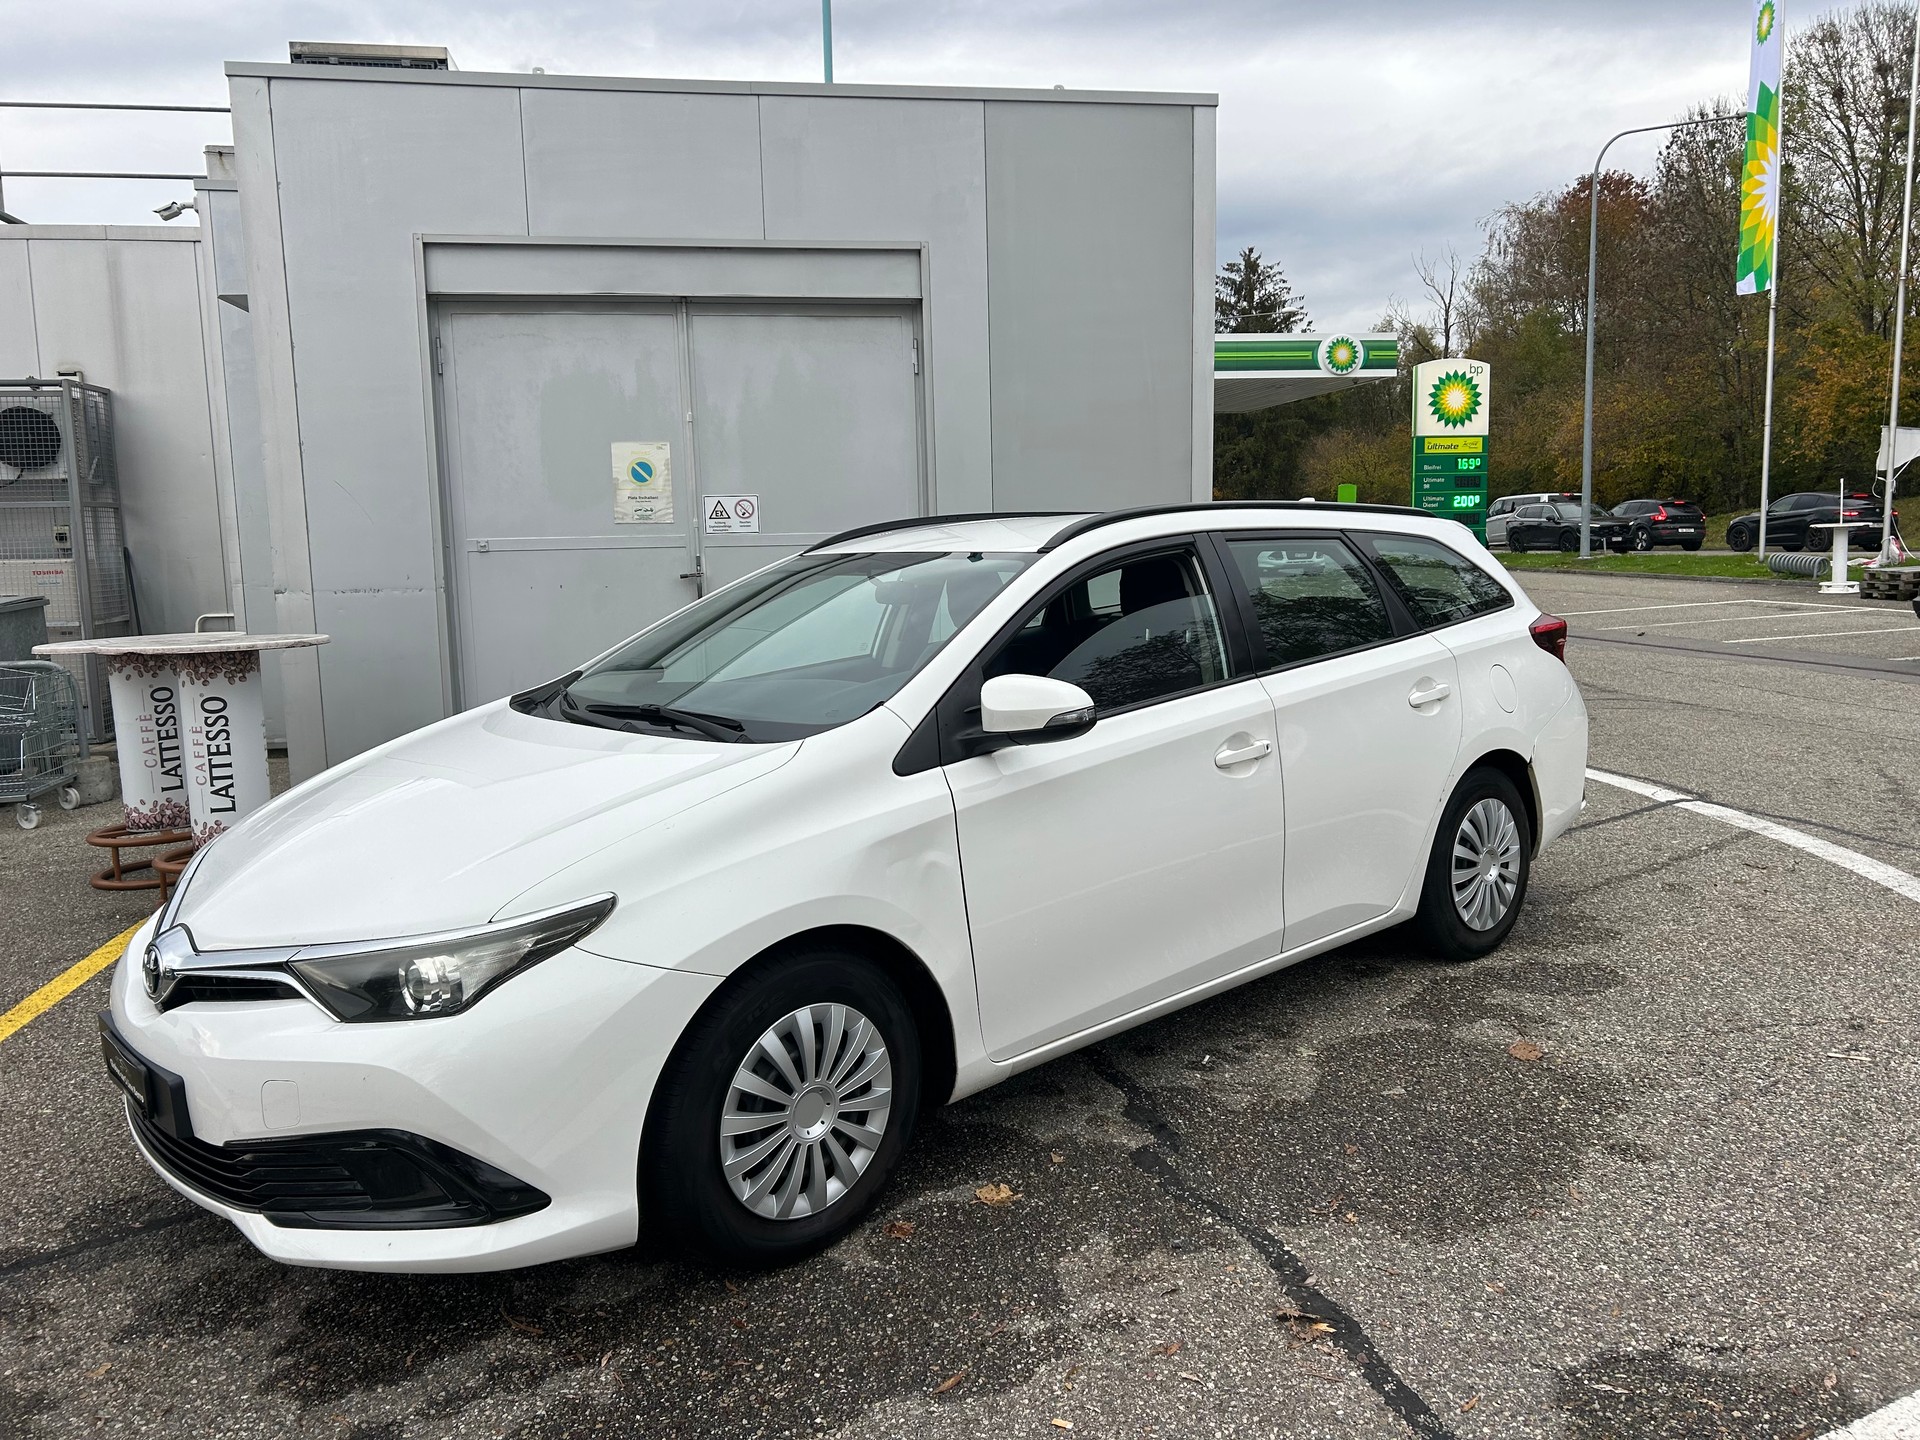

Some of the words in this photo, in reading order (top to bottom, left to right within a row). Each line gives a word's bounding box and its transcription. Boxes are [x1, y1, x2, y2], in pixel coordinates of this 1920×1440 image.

[1469, 363, 1484, 376] bp
[136, 713, 158, 768] CAFFÈ
[150, 686, 185, 793] LATTESSO
[189, 725, 207, 786] CAFFÈ
[200, 696, 237, 815] LATTESSO
